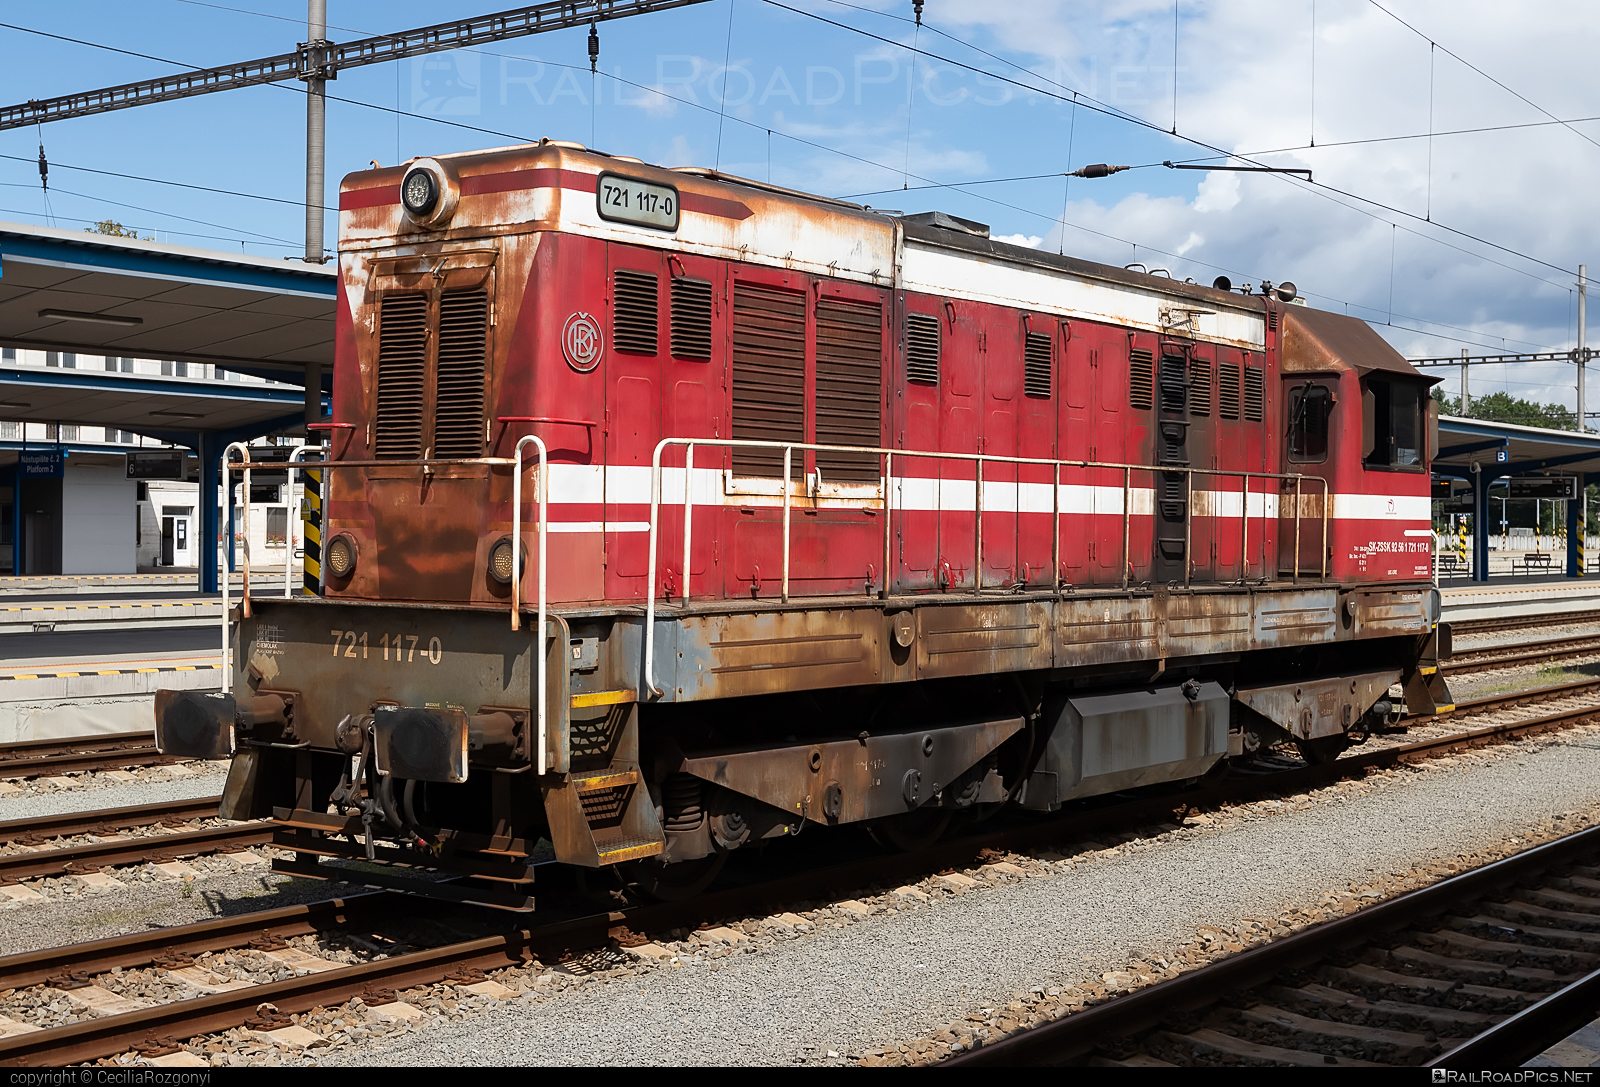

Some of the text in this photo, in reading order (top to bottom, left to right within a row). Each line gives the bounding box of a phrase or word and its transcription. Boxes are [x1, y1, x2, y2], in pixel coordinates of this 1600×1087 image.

[603, 185, 673, 216] 721 117-0
[56, 455, 60, 463] 2
[1497, 452, 1506, 462] B
[26, 464, 54, 473] Platform 2
[129, 464, 135, 474] 6
[1565, 486, 1571, 495] 5
[1368, 541, 1391, 552] SK-ZSSK
[1391, 542, 1398, 552] 92
[1398, 542, 1404, 552] 56
[1408, 542, 1417, 552] 721
[1417, 542, 1429, 552] 117-0
[330, 629, 442, 665] 721 117-0
